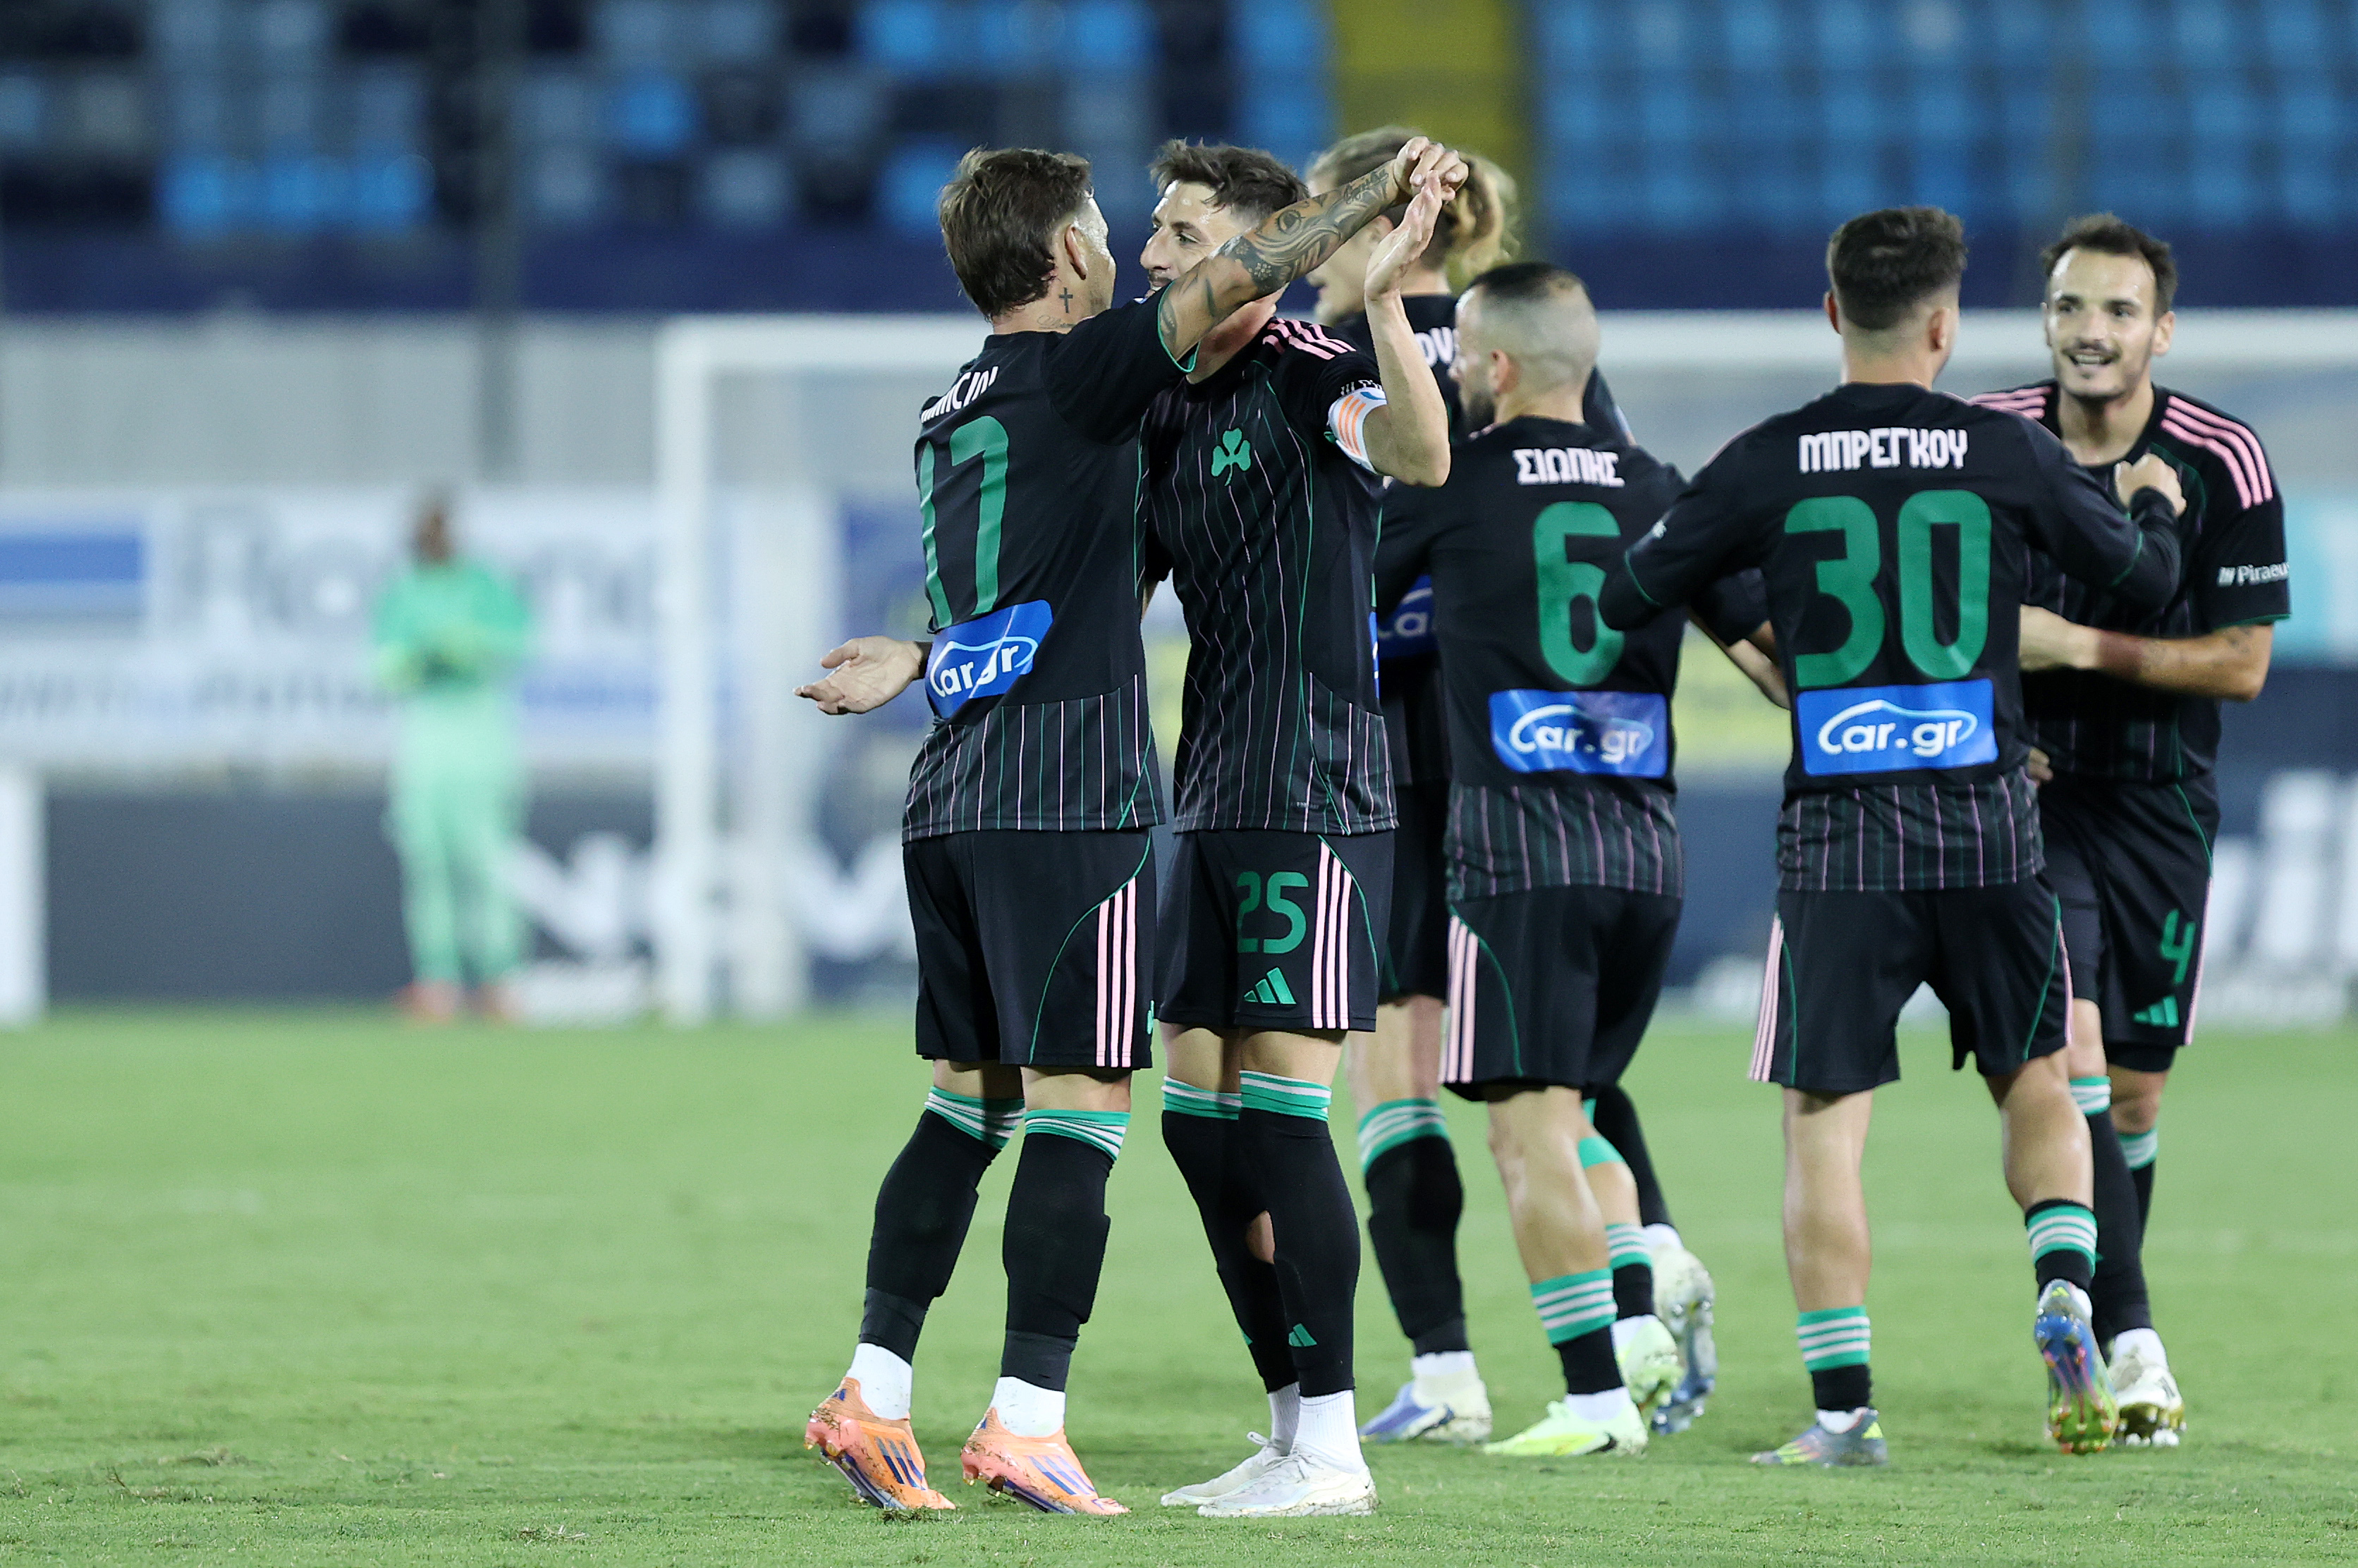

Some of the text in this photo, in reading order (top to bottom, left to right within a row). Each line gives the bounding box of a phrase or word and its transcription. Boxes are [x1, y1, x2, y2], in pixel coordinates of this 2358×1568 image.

[921, 366, 998, 423] CINI
[1512, 447, 1625, 488] ΣΙΩΠΗΣ
[1799, 427, 1969, 474] ΜΠΡΕΓΚΟΥ
[920, 416, 1009, 626] 17
[1533, 501, 1625, 685] 6
[1784, 489, 1992, 687] 30
[2236, 563, 2289, 585] Piraeu
[1509, 704, 1654, 764] Car.gr
[1818, 699, 1978, 757] Car.gr
[1236, 871, 1309, 954] 25
[2161, 907, 2197, 986] 4
